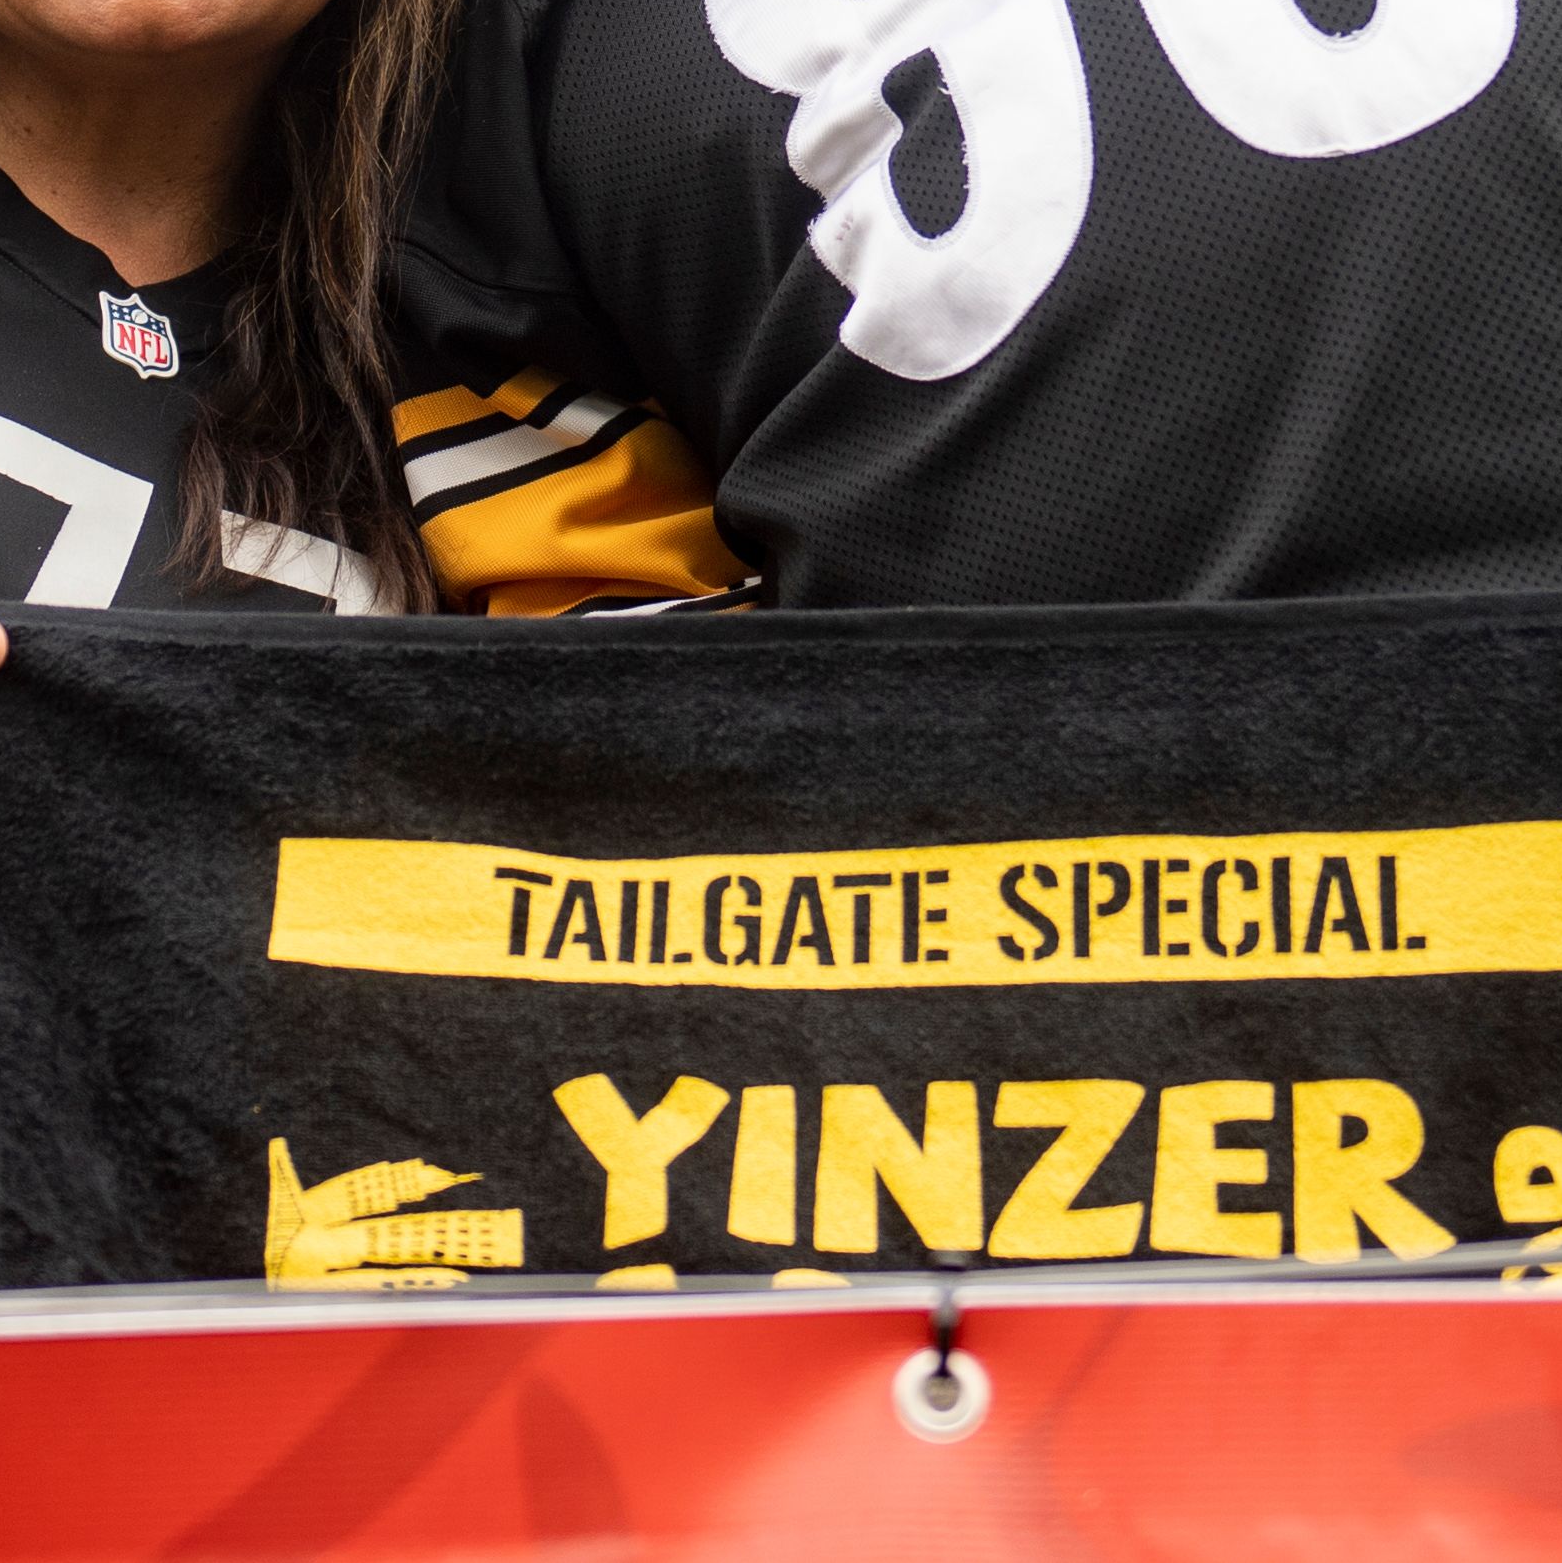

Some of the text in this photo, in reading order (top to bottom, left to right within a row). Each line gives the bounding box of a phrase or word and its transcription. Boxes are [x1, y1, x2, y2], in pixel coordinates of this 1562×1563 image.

[116, 322, 168, 365] NFL
[494, 854, 1427, 966] TAILGATE SPECIAL
[552, 1072, 1458, 1263] YINZER
